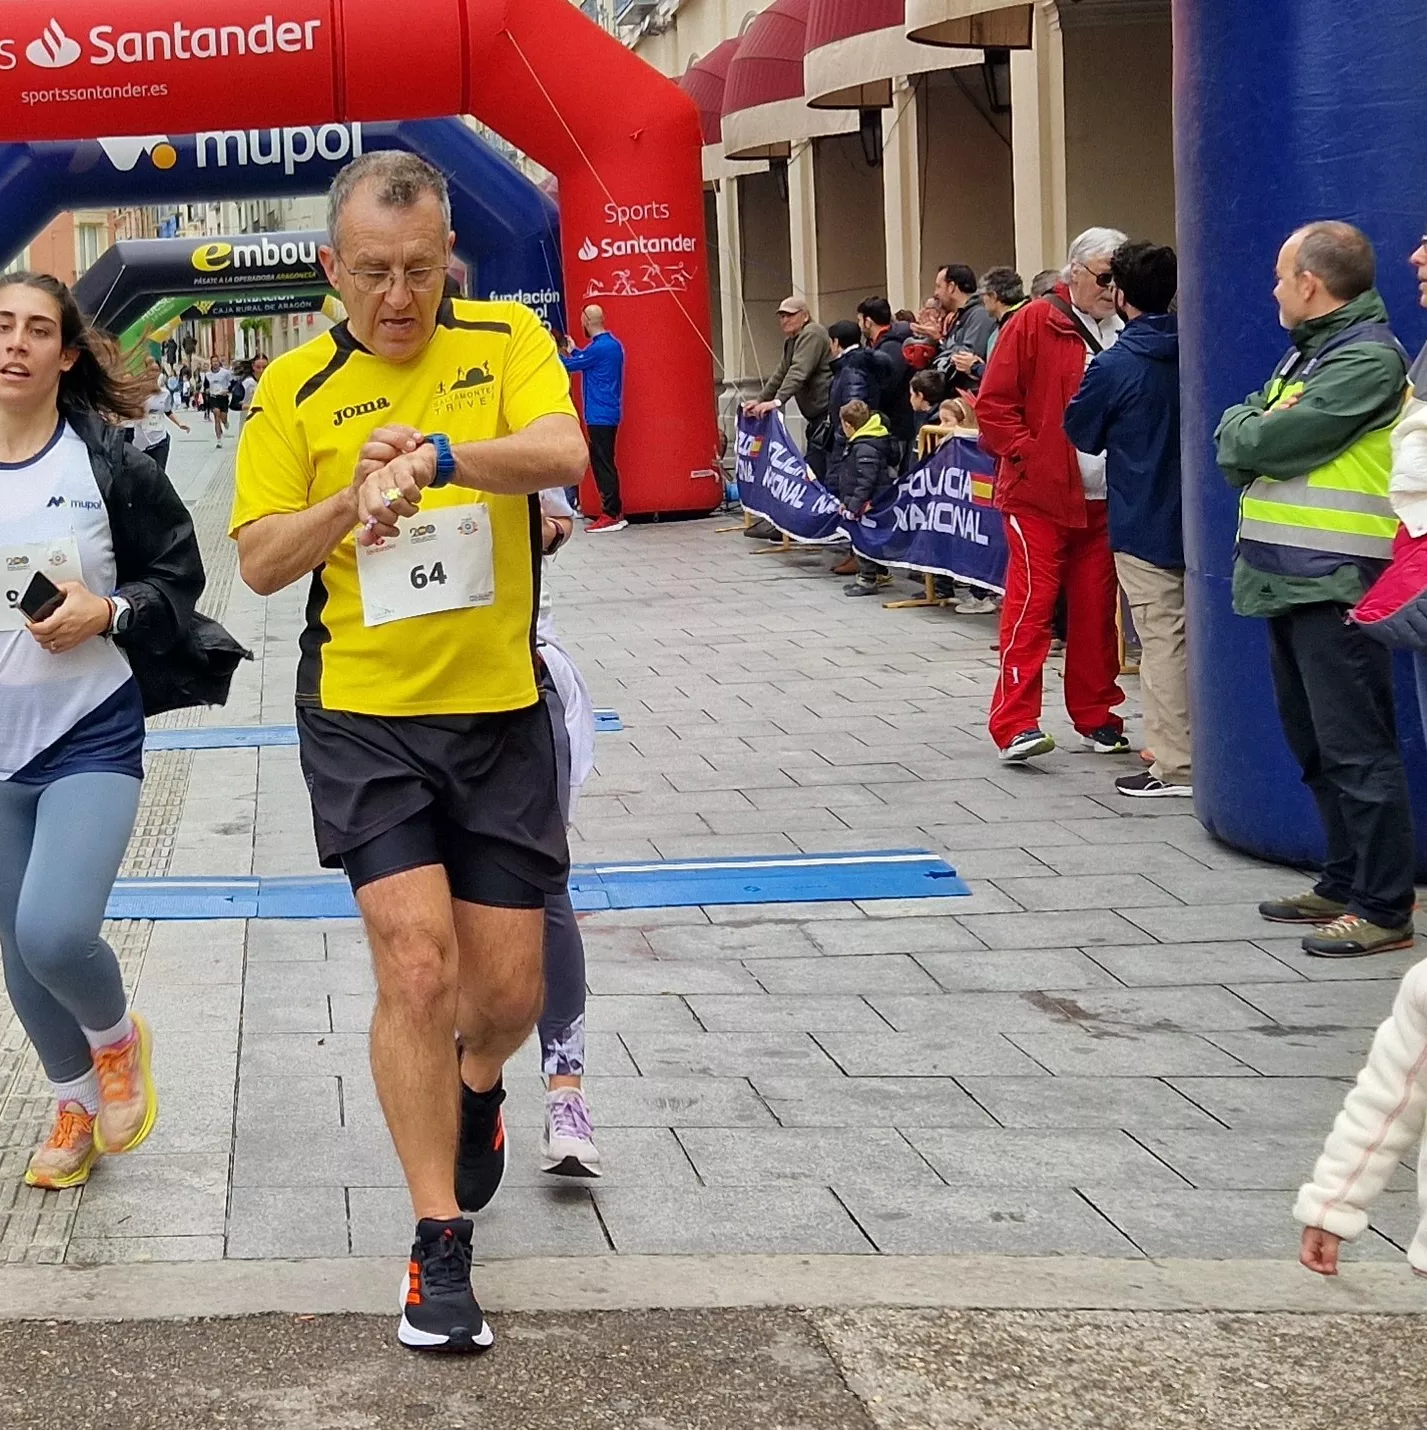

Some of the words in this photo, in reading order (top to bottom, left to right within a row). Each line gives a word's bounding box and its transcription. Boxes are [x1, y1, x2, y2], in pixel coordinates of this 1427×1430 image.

[89, 15, 321, 65] Santander
[21, 81, 168, 105] sportssantander.es
[196, 122, 362, 174] mupol
[604, 201, 670, 226] Sports
[191, 238, 316, 271] embou
[601, 233, 696, 258] Santander
[236, 305, 263, 313] RURAL
[333, 397, 390, 426] Joma
[71, 499, 102, 511] mupol
[410, 561, 447, 589] 64
